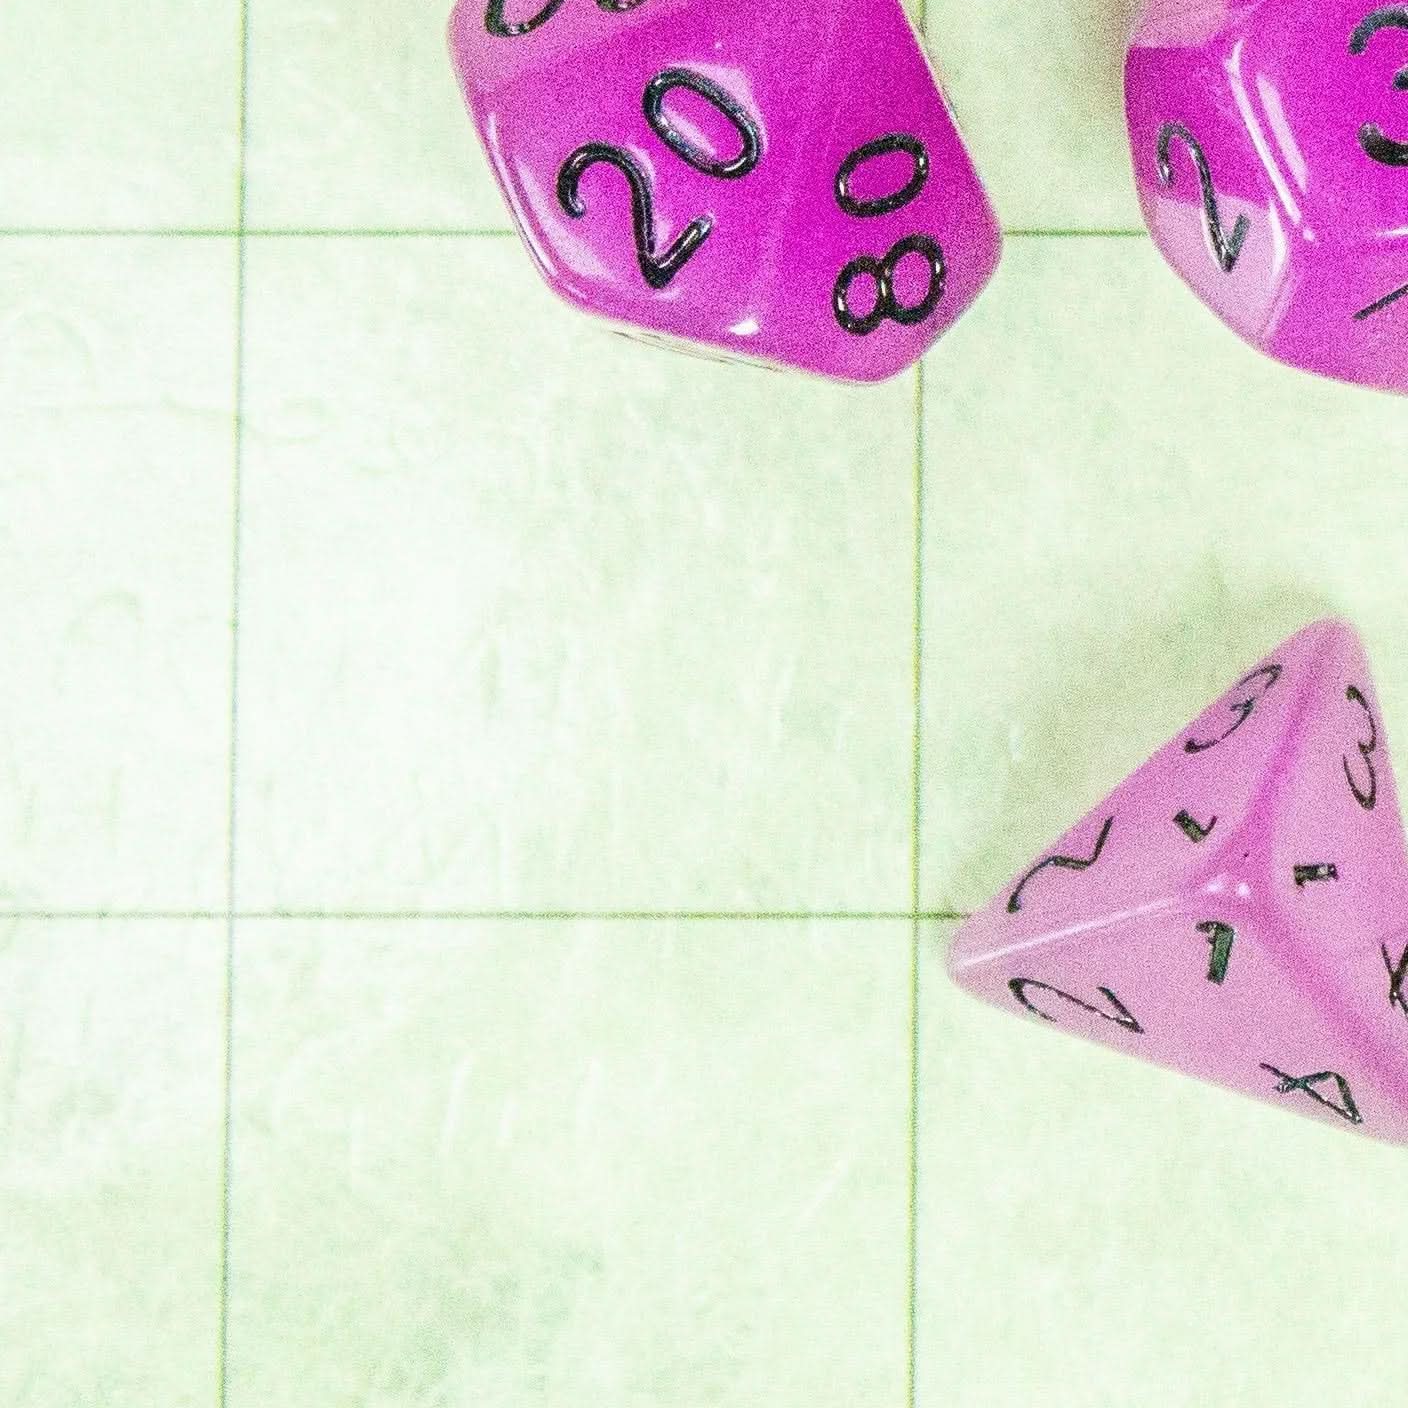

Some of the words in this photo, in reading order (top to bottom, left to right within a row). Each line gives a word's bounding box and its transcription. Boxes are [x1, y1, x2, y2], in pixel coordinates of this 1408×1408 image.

[555, 67, 763, 291] 20
[830, 132, 949, 338] 80
[1156, 124, 1246, 273] 2
[1195, 920, 1236, 985] 1
